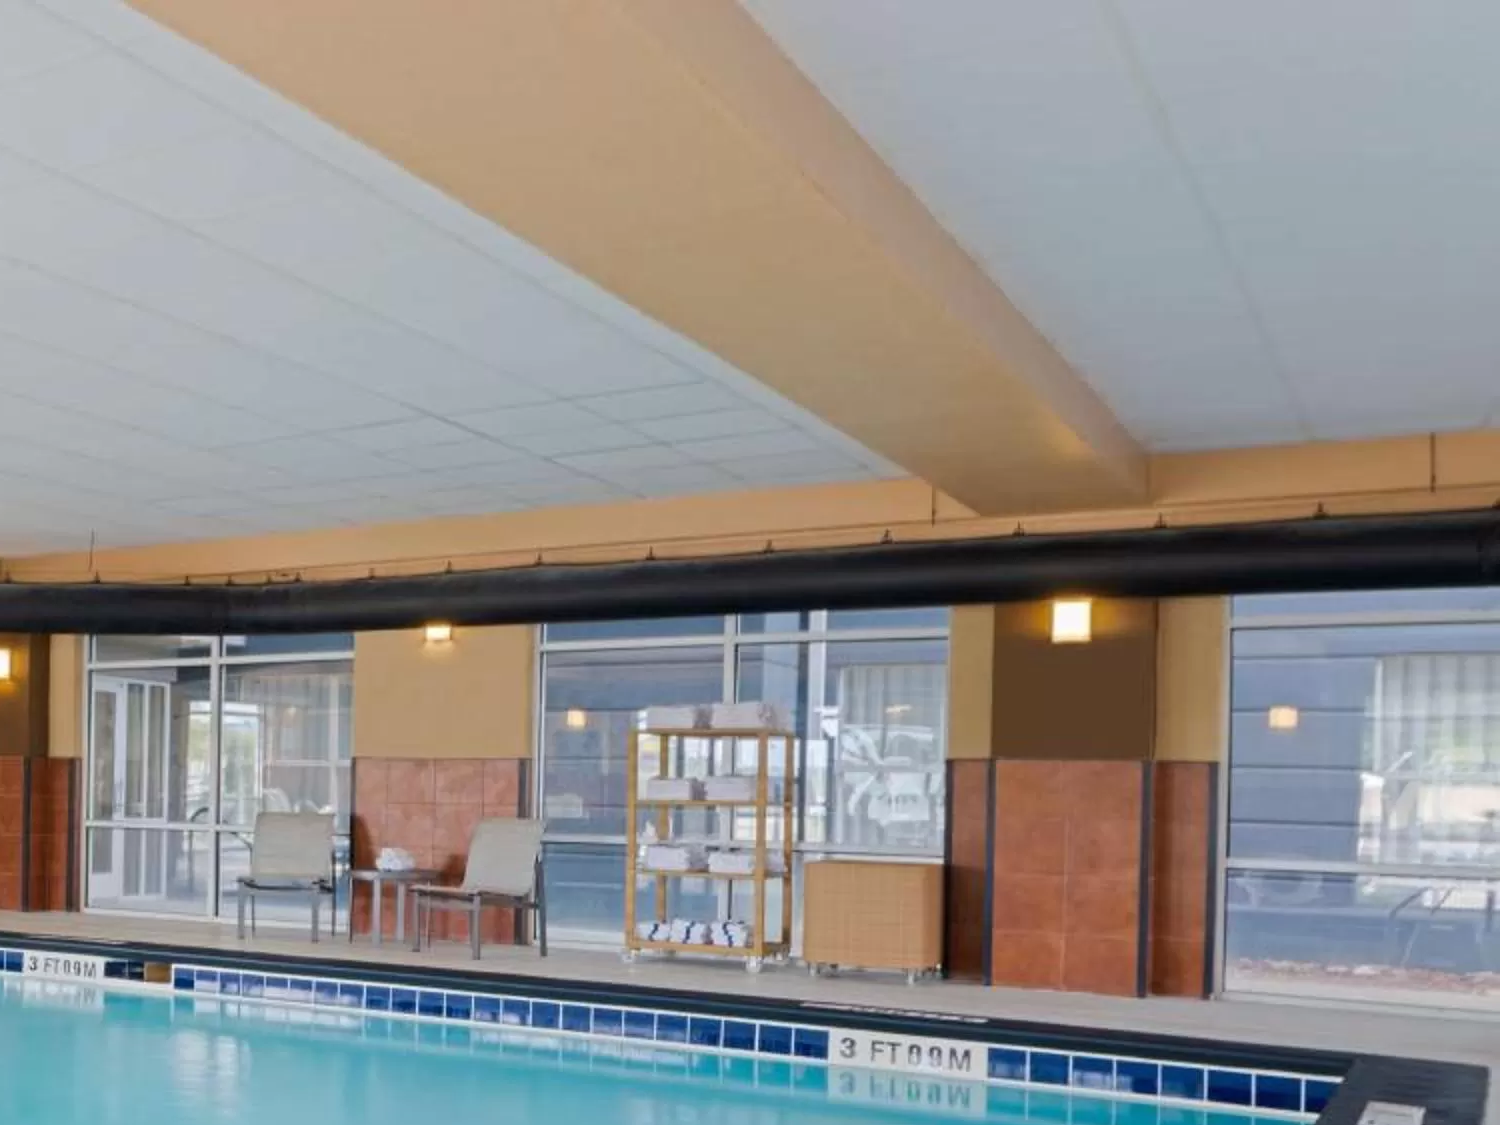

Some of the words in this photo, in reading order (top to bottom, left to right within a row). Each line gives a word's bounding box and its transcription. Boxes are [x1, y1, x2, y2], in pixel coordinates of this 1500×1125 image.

[28, 955, 38, 972] 3
[43, 957, 61, 975] FT
[839, 1037, 857, 1059] 3
[869, 1040, 902, 1066] FT
[948, 1047, 972, 1073] M
